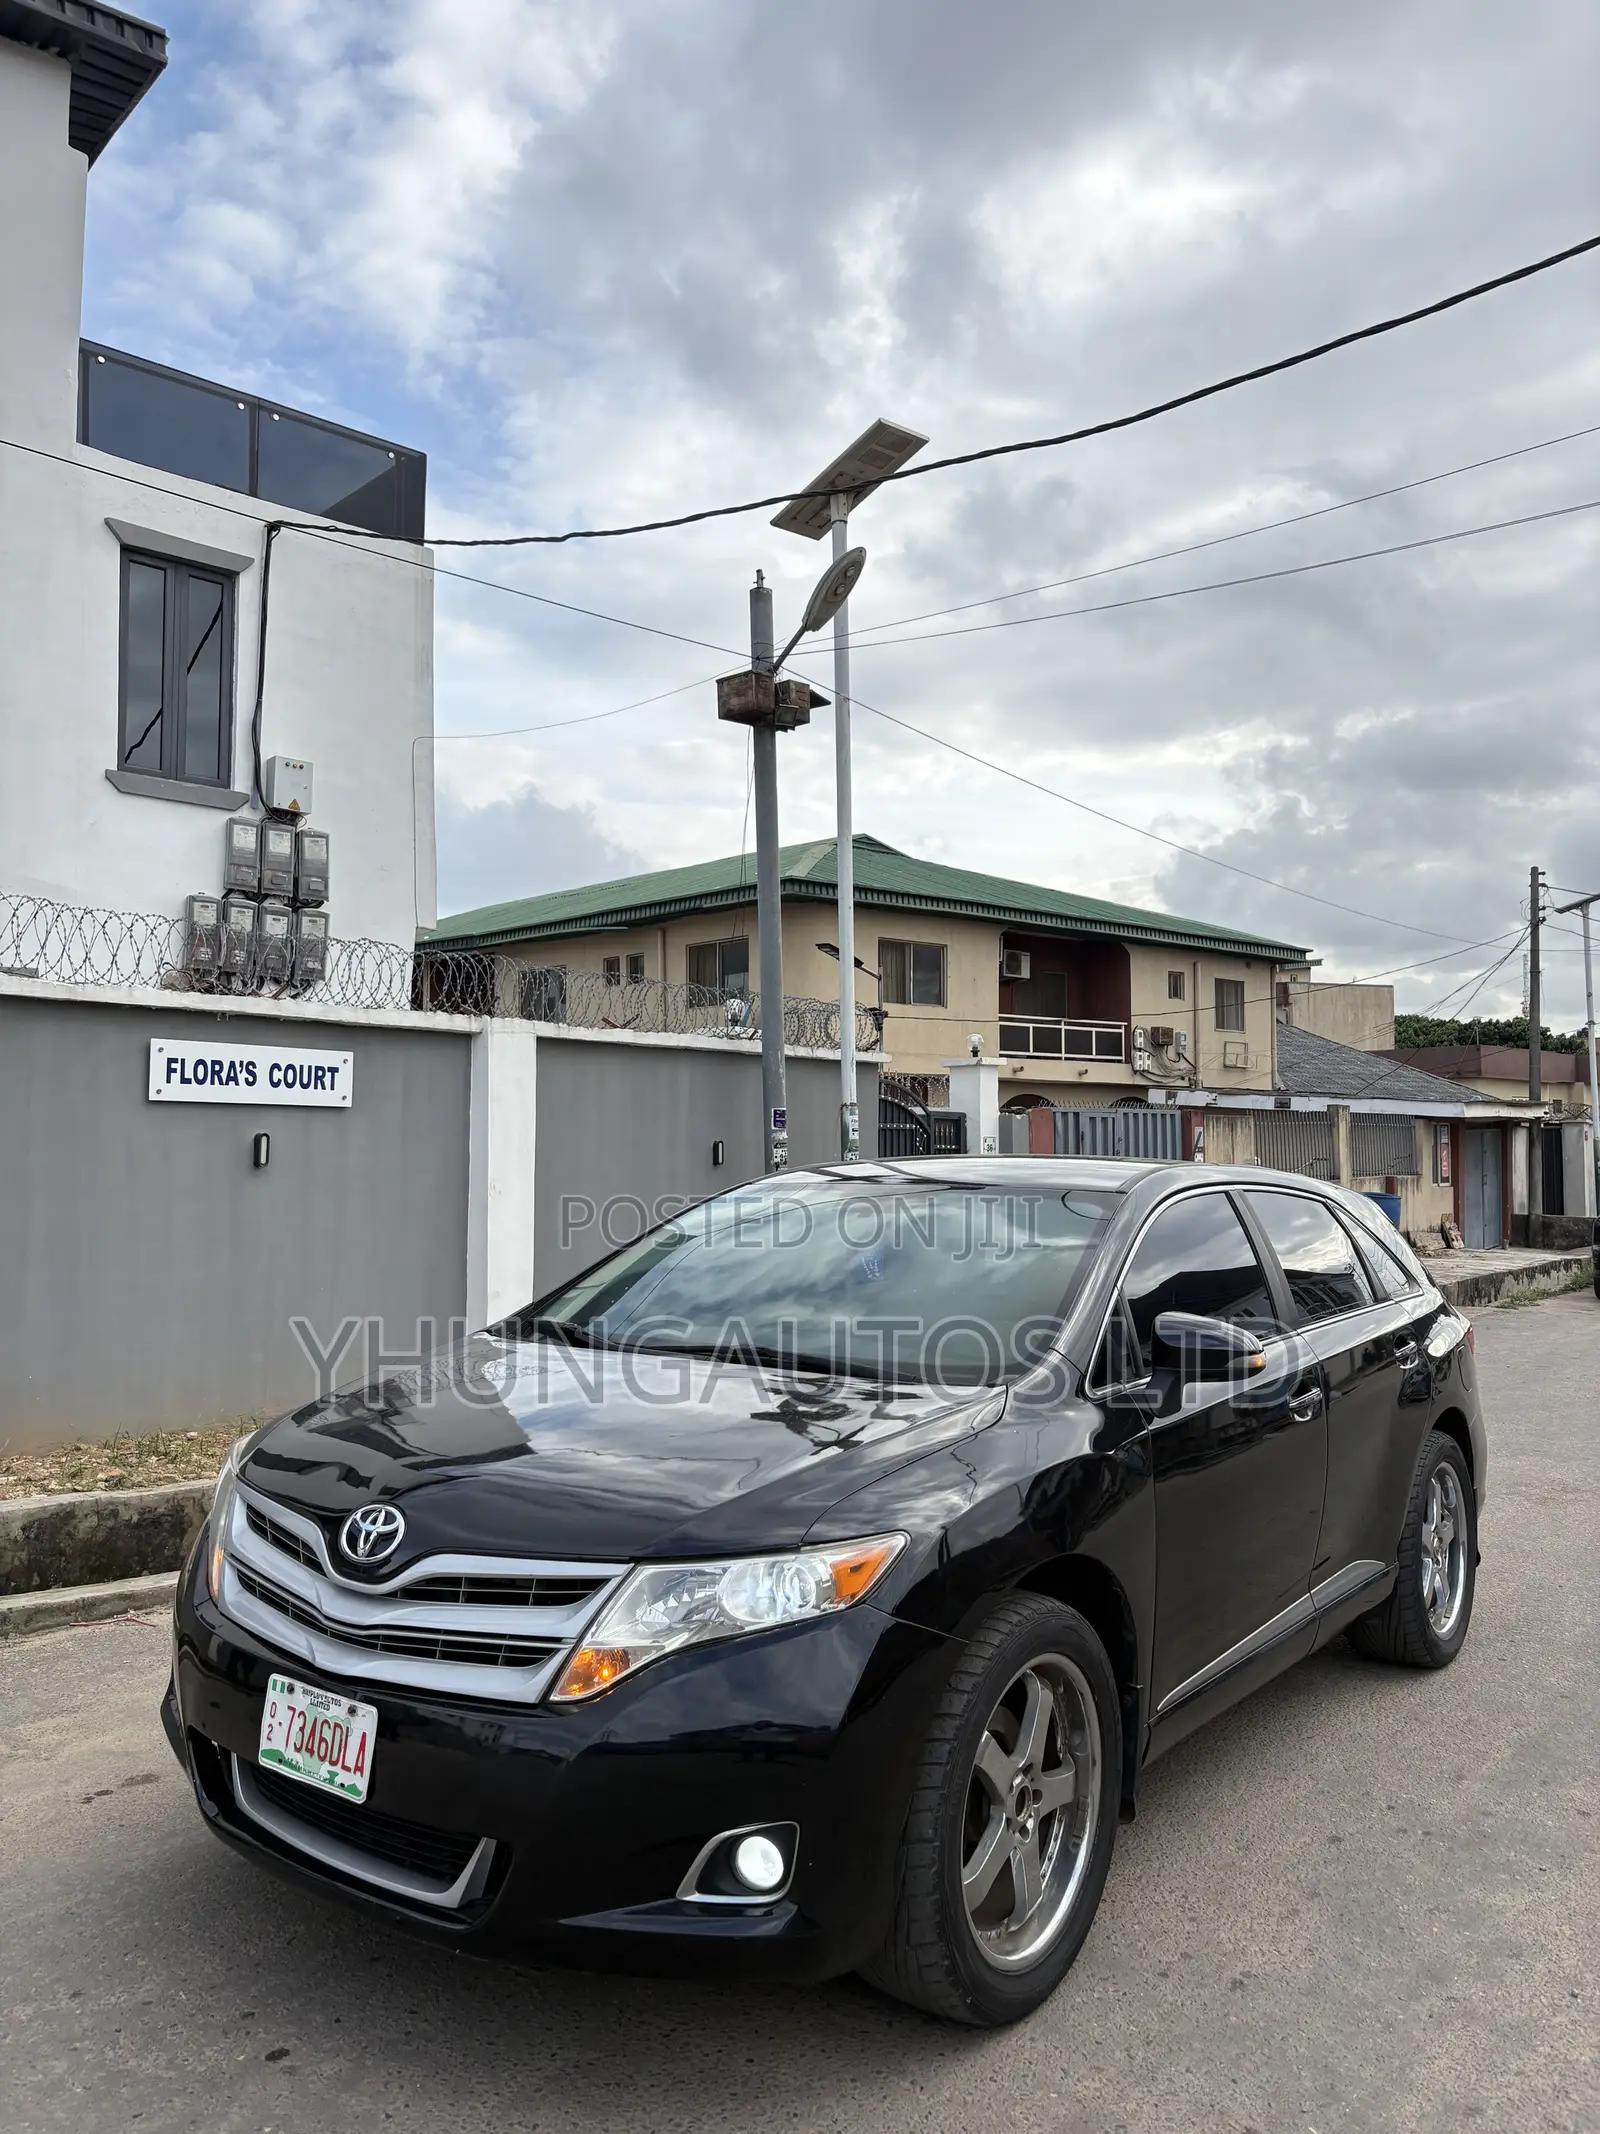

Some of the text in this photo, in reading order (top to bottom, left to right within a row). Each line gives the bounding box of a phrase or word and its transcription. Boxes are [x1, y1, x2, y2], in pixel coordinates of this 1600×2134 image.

[165, 1057, 340, 1091] FLORA'S COURT
[285, 1705, 367, 1778] 7346DLA
